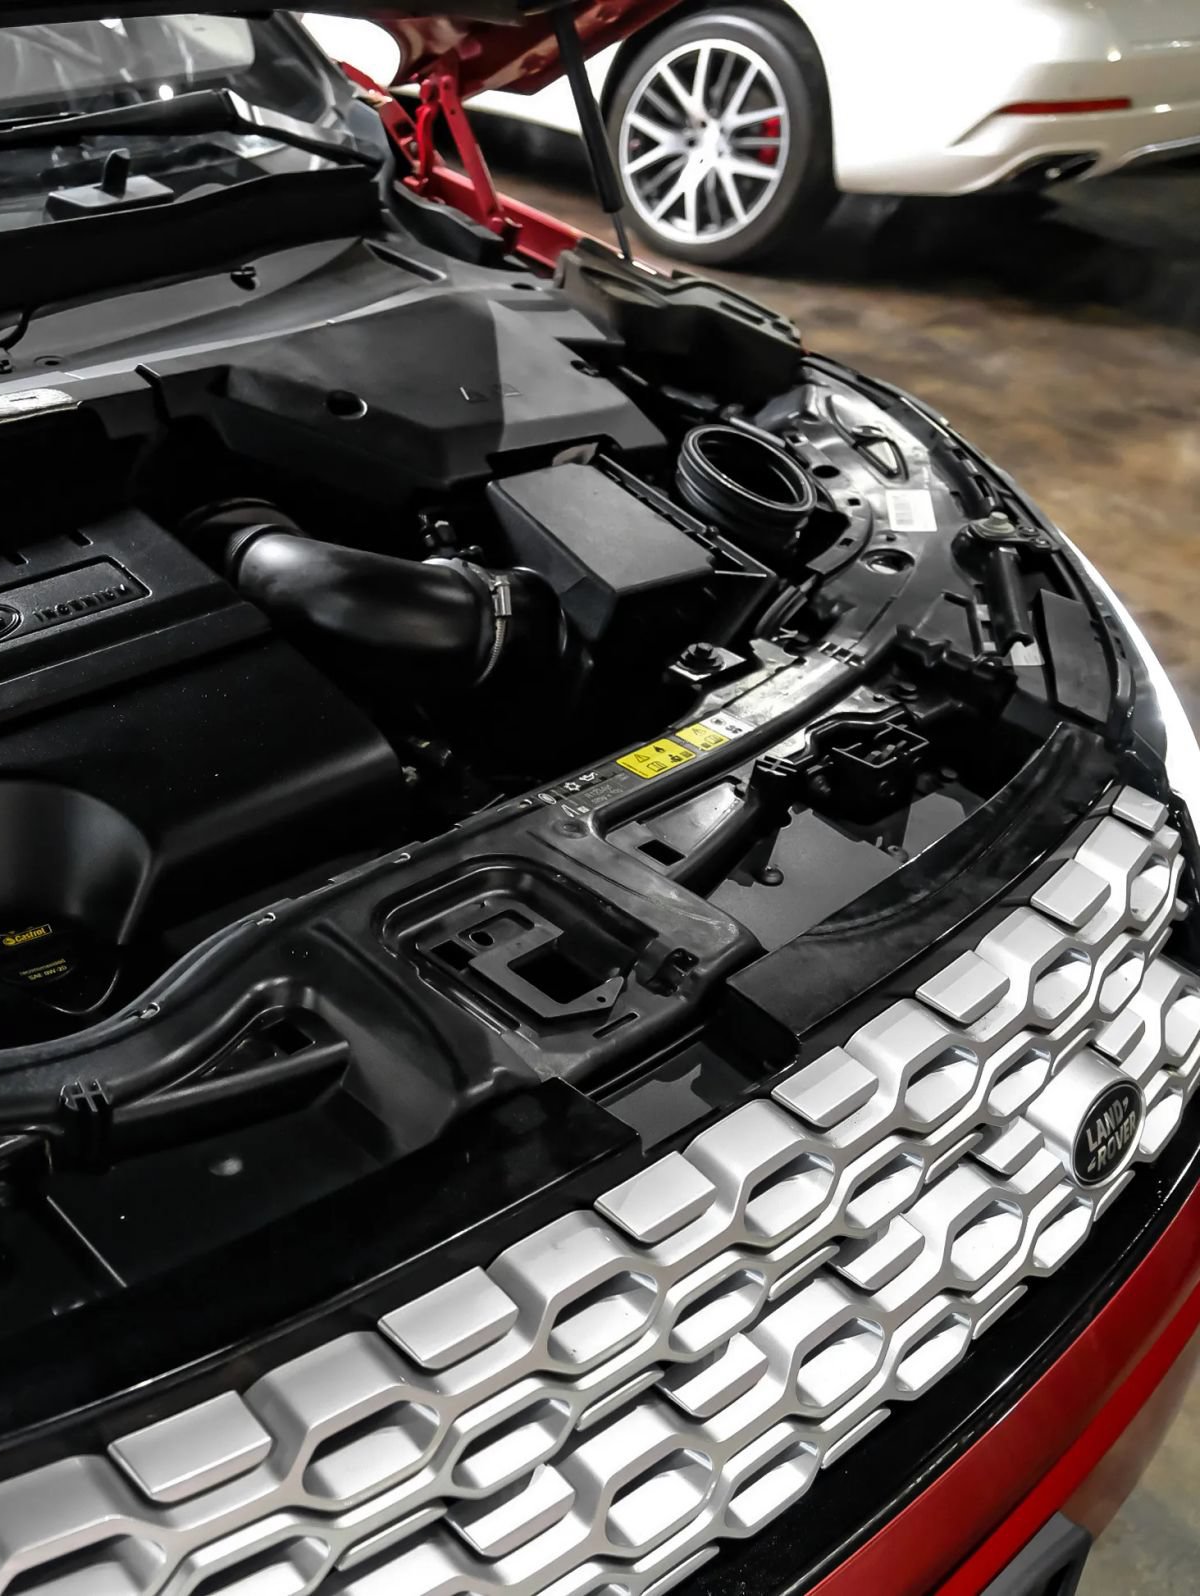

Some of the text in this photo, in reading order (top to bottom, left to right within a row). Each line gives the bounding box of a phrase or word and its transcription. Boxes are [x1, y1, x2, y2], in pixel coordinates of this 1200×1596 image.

[14, 927, 47, 944] Castrol
[1086, 1099, 1125, 1153] LAND
[1097, 1110, 1137, 1172] ROVER
